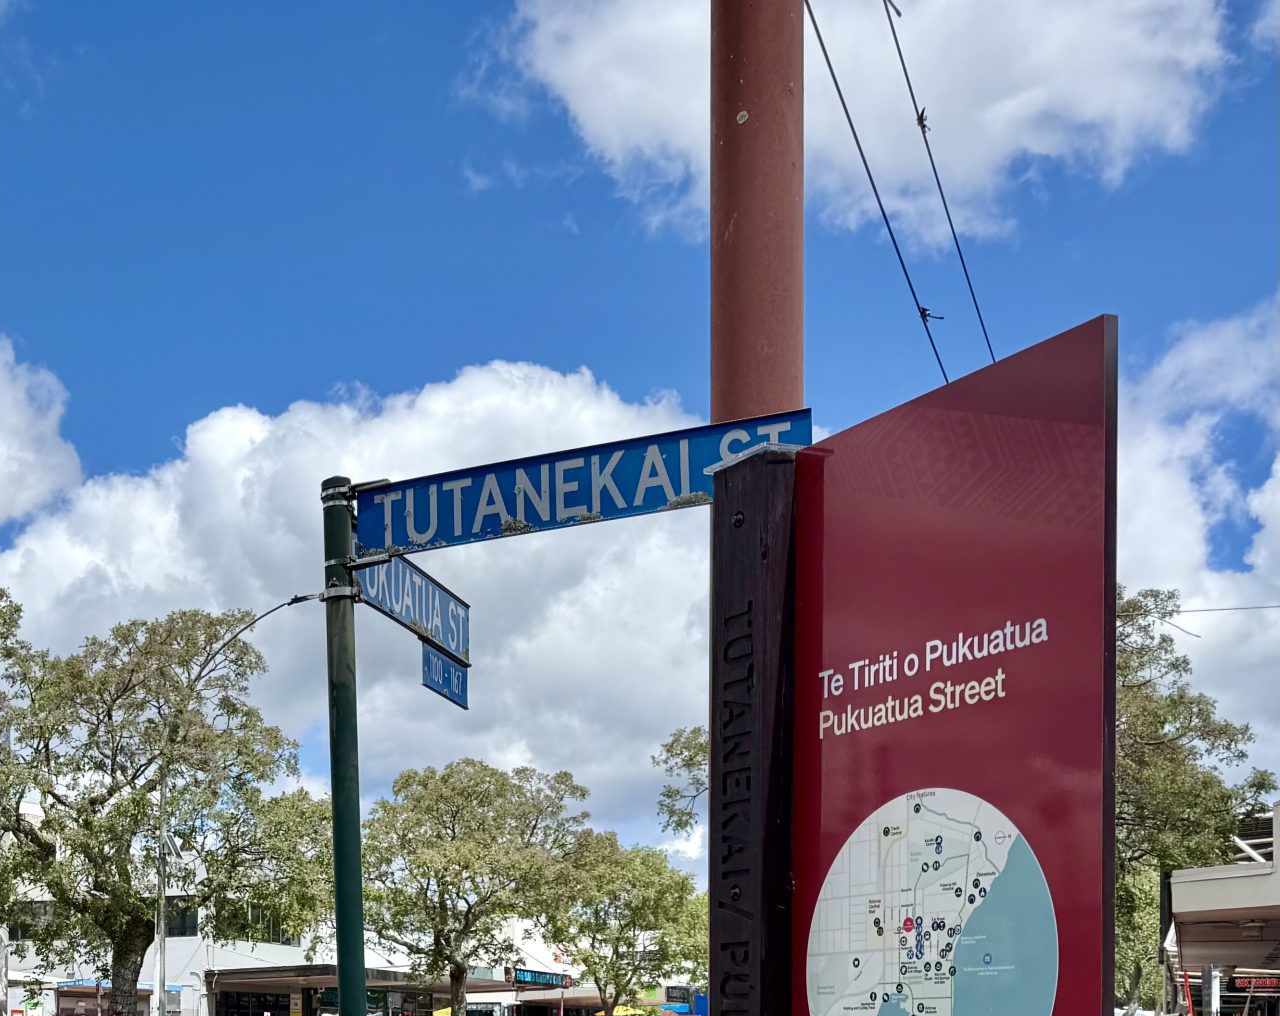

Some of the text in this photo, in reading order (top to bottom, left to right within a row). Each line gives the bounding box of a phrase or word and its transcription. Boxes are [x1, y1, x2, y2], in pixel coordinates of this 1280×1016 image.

[374, 438, 689, 546] TUTANEKAI
[365, 558, 466, 653] UKUATUA ST
[450, 665, 463, 696] 1167
[819, 617, 1049, 699] Te Tiriti o Pukuatua
[818, 667, 1006, 740] Pukuatua Street
